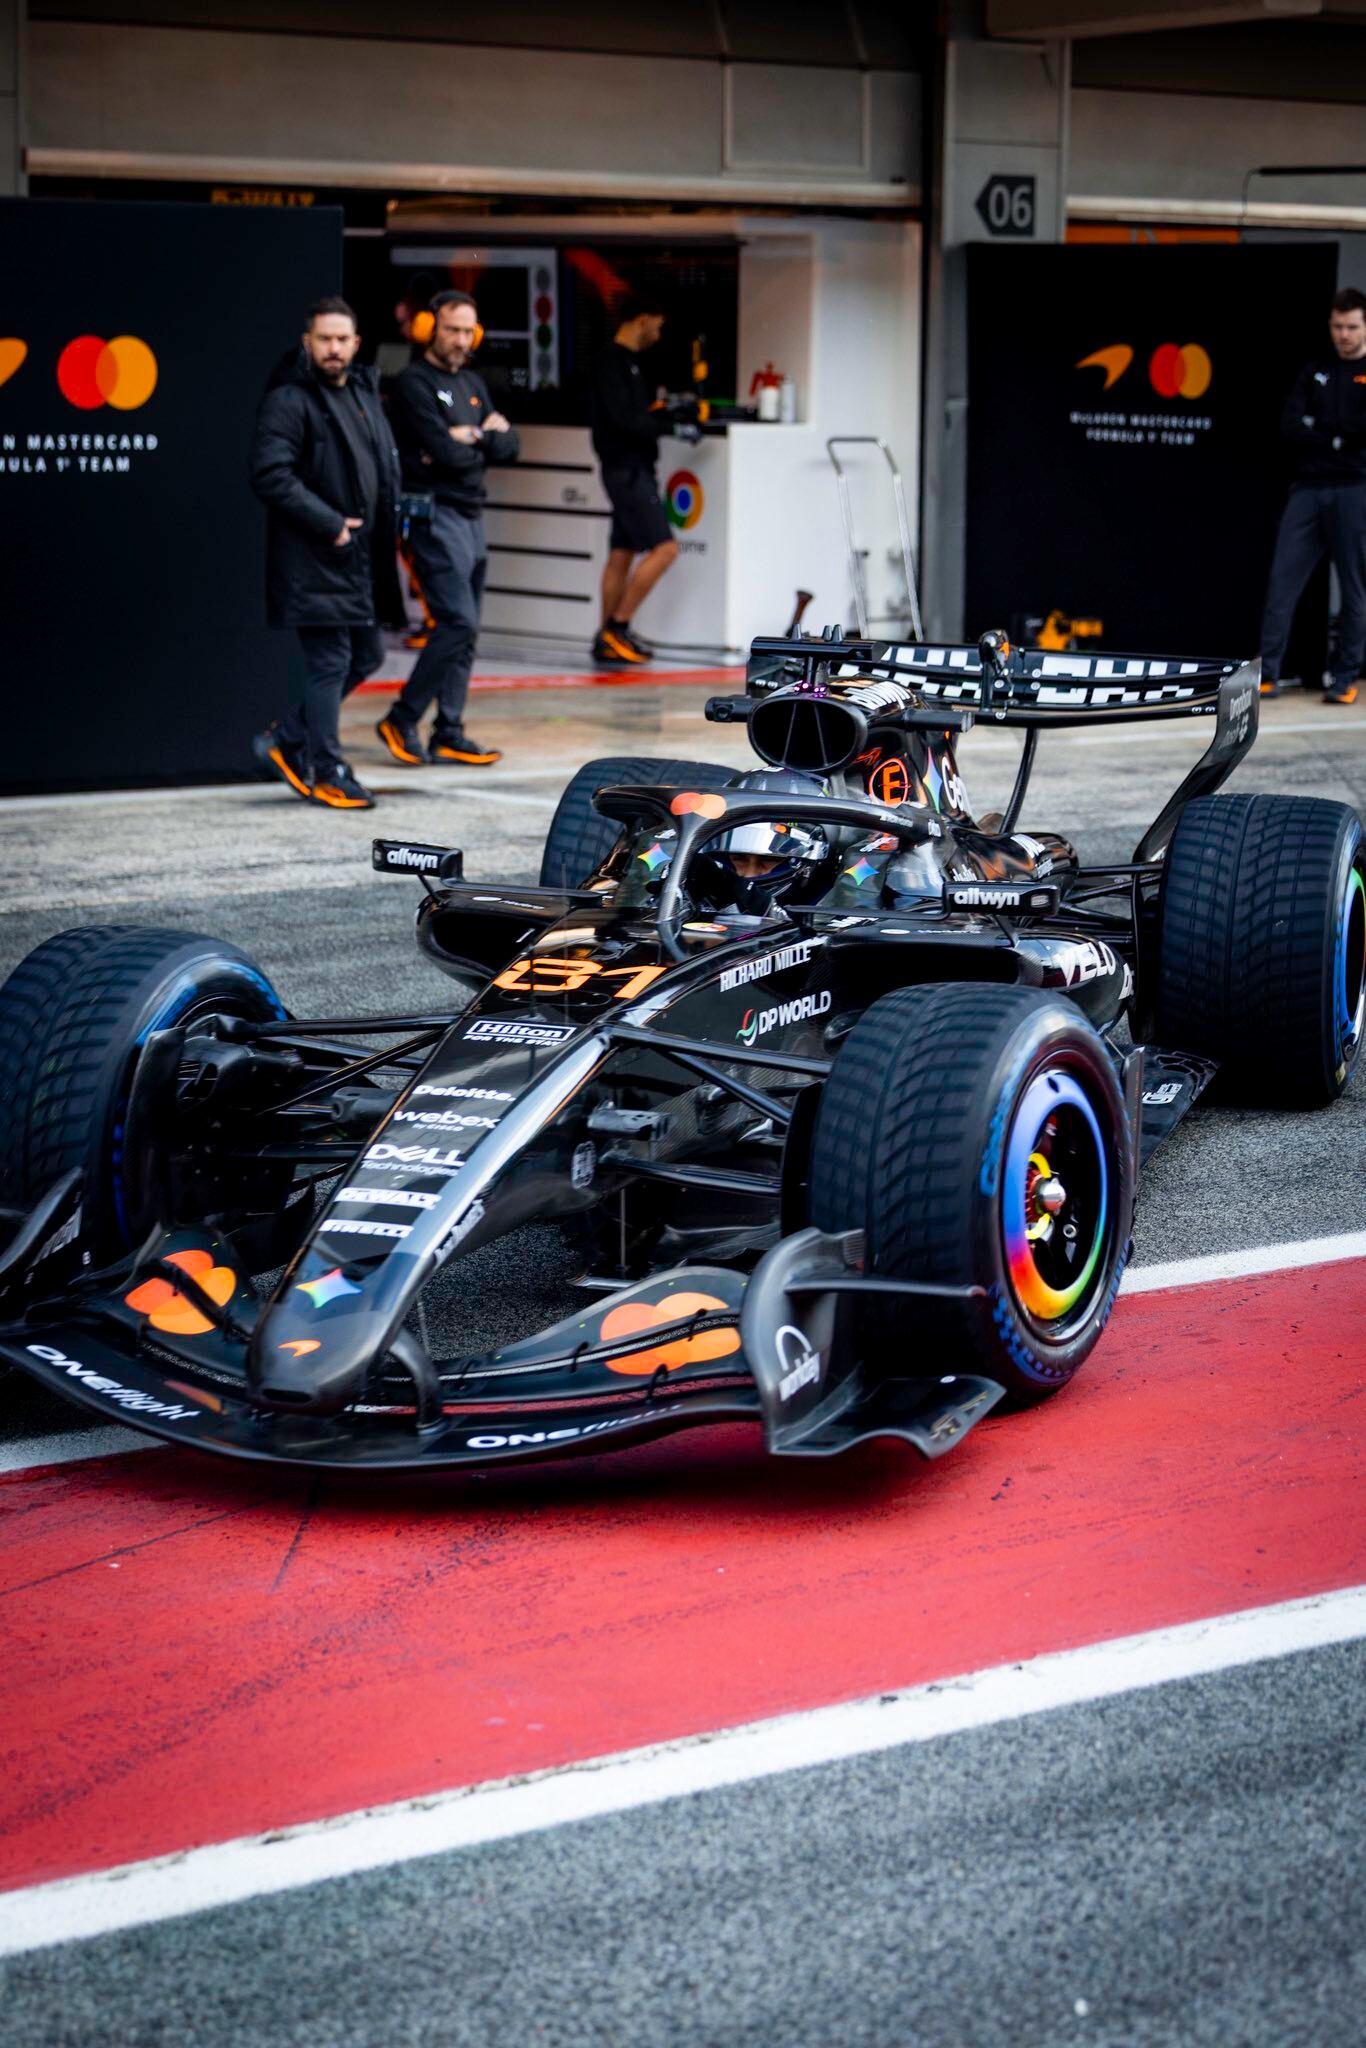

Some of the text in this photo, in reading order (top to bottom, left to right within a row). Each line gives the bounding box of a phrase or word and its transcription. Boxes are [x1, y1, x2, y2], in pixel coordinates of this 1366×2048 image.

[988, 184, 1032, 228] 06
[27, 434, 158, 450] MASTERCARD
[1160, 431, 1195, 445] TEAM
[78, 456, 130, 473] TEAM
[386, 847, 438, 870] allwyn
[953, 888, 1020, 909] allwyn
[720, 946, 811, 992] RICHARD MILLE
[1051, 941, 1117, 987] VELO
[493, 957, 668, 999] 81
[758, 990, 832, 1034] DP WORLD
[478, 1022, 564, 1038] Hilton
[495, 1036, 525, 1044] THE
[525, 1039, 563, 1047] STAY
[394, 1111, 501, 1129] webex
[363, 1144, 466, 1167] DELL
[361, 1160, 460, 1177] Technologies
[26, 1344, 201, 1421] ONEflight
